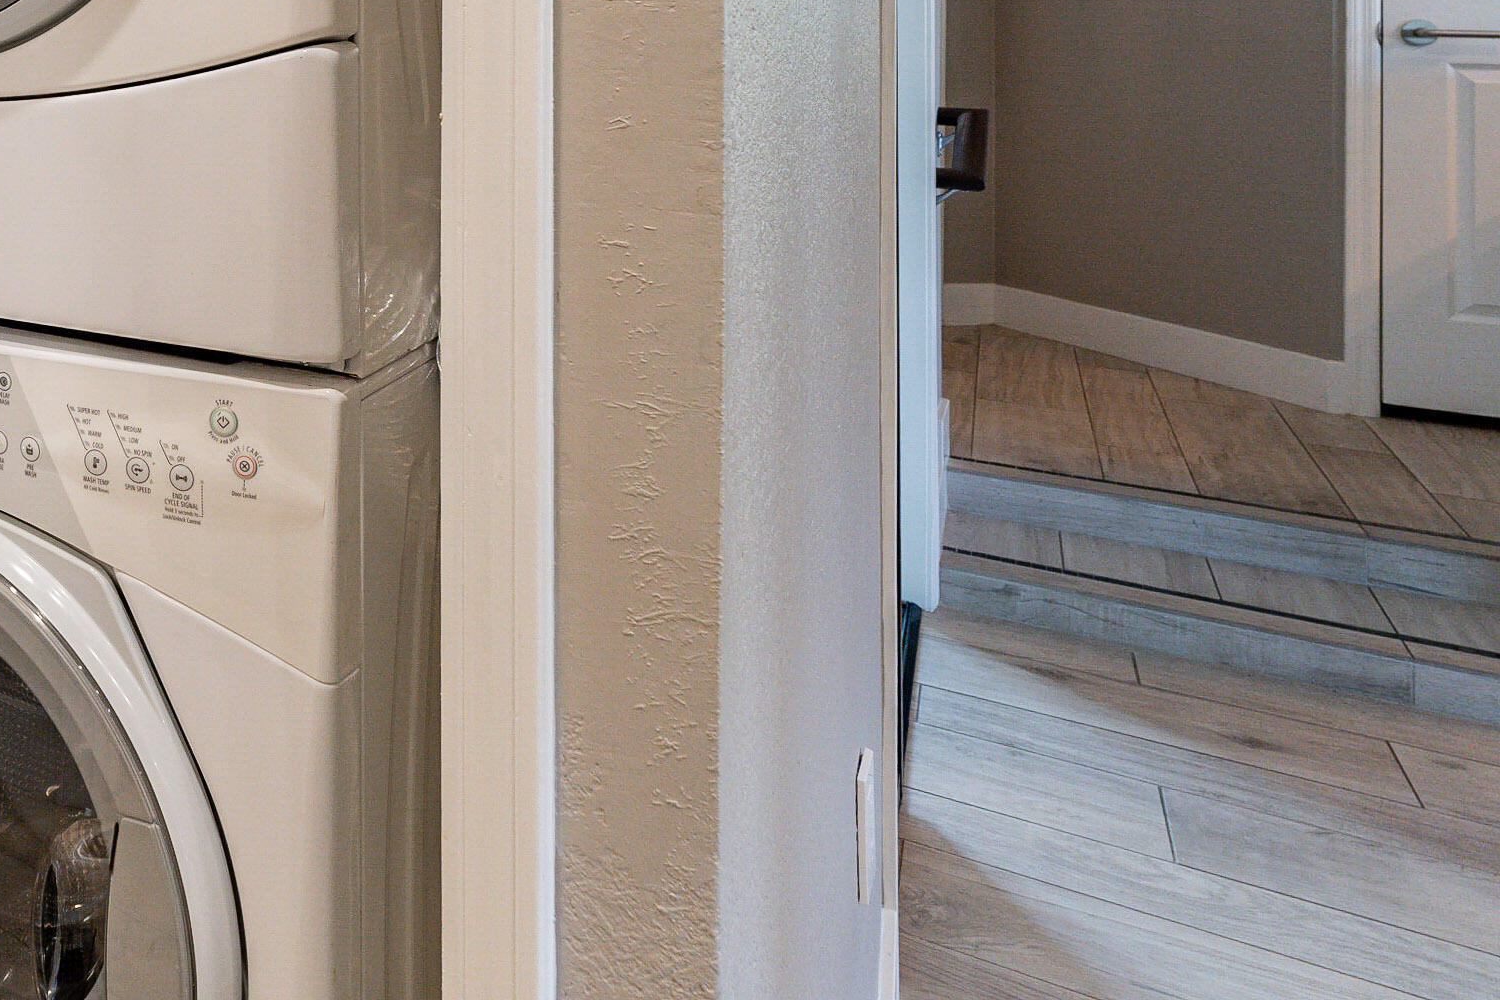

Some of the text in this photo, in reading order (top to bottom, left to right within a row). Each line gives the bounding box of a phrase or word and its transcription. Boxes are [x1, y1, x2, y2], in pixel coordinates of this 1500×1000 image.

[215, 399, 233, 407] START
[77, 406, 90, 414] SUPER
[123, 425, 142, 433] MEDIUM
[88, 430, 101, 438] WARM
[226, 446, 241, 462] PAUSE
[26, 463, 34, 471] PRE
[24, 470, 37, 478] WASH
[83, 475, 96, 483] WASH
[136, 486, 151, 494] SPEED
[164, 498, 198, 510] CYCLE SIGNAL
